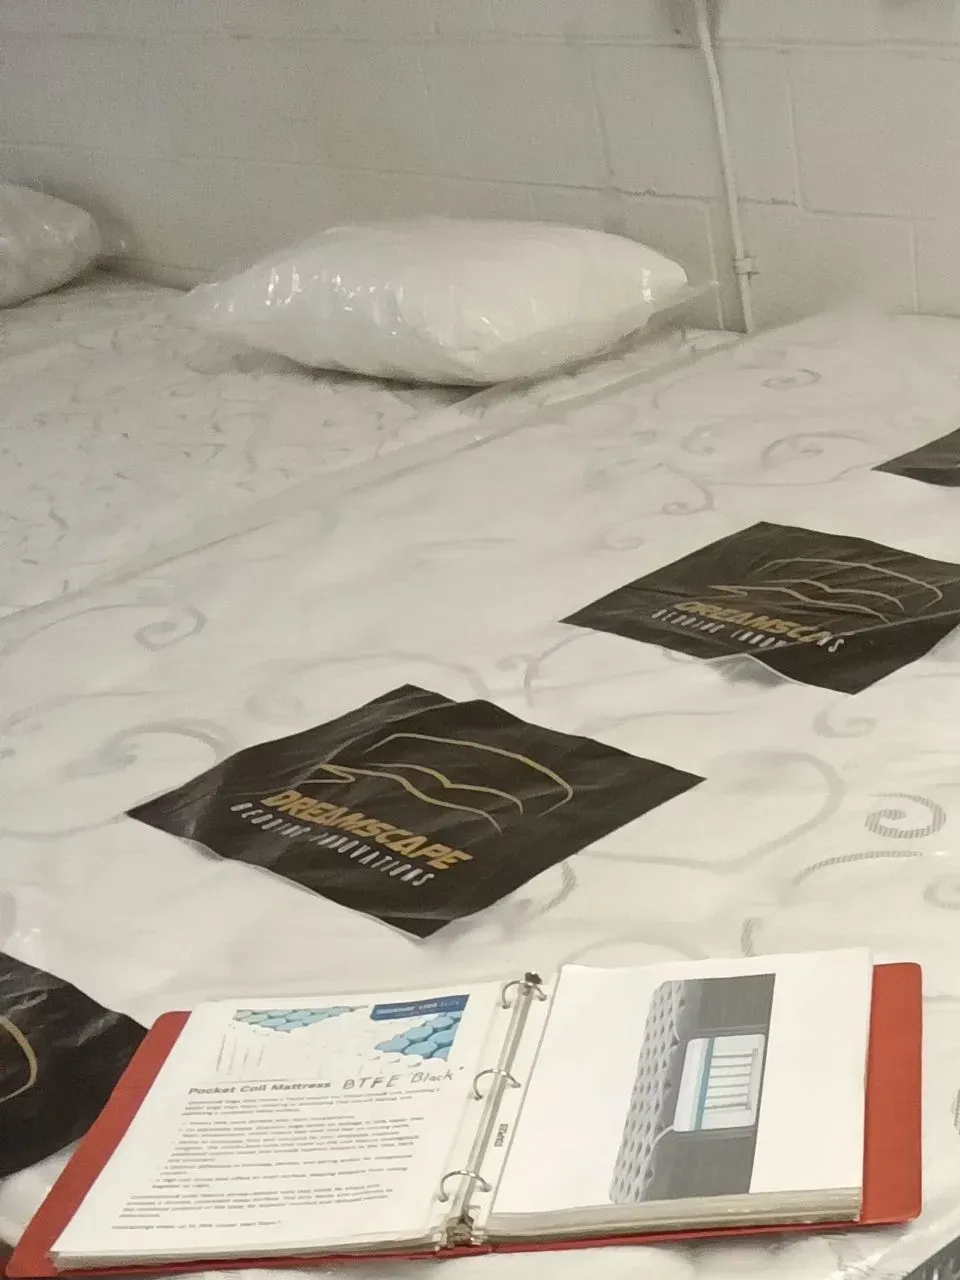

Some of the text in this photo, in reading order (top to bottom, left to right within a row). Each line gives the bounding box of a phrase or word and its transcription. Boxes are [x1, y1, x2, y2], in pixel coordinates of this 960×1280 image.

[230, 802, 436, 887] BEDDING INNOVATIONS
[260, 789, 474, 871] DREAMSCAPE
[188, 1081, 331, 1095] Pocket Coil Mattress
